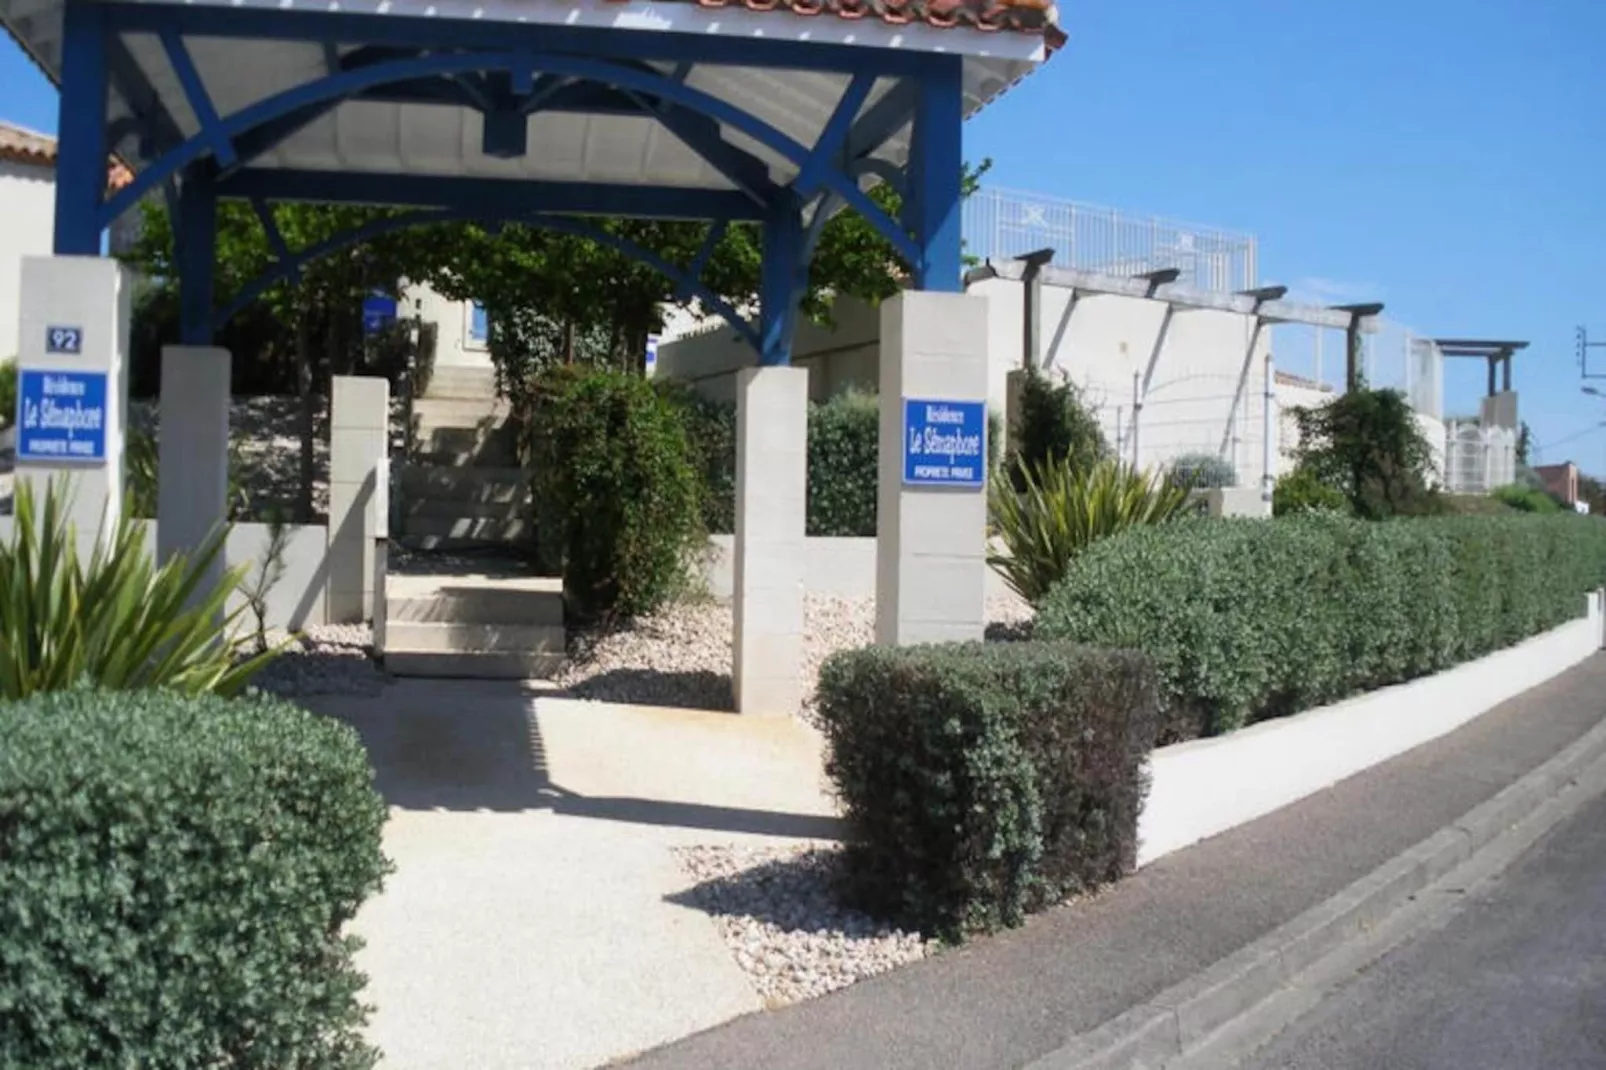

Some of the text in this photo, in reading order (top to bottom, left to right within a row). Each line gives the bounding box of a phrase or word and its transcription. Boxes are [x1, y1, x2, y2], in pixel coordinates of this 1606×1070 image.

[53, 330, 77, 349] 92
[24, 397, 38, 428] Le
[909, 426, 922, 454] Le
